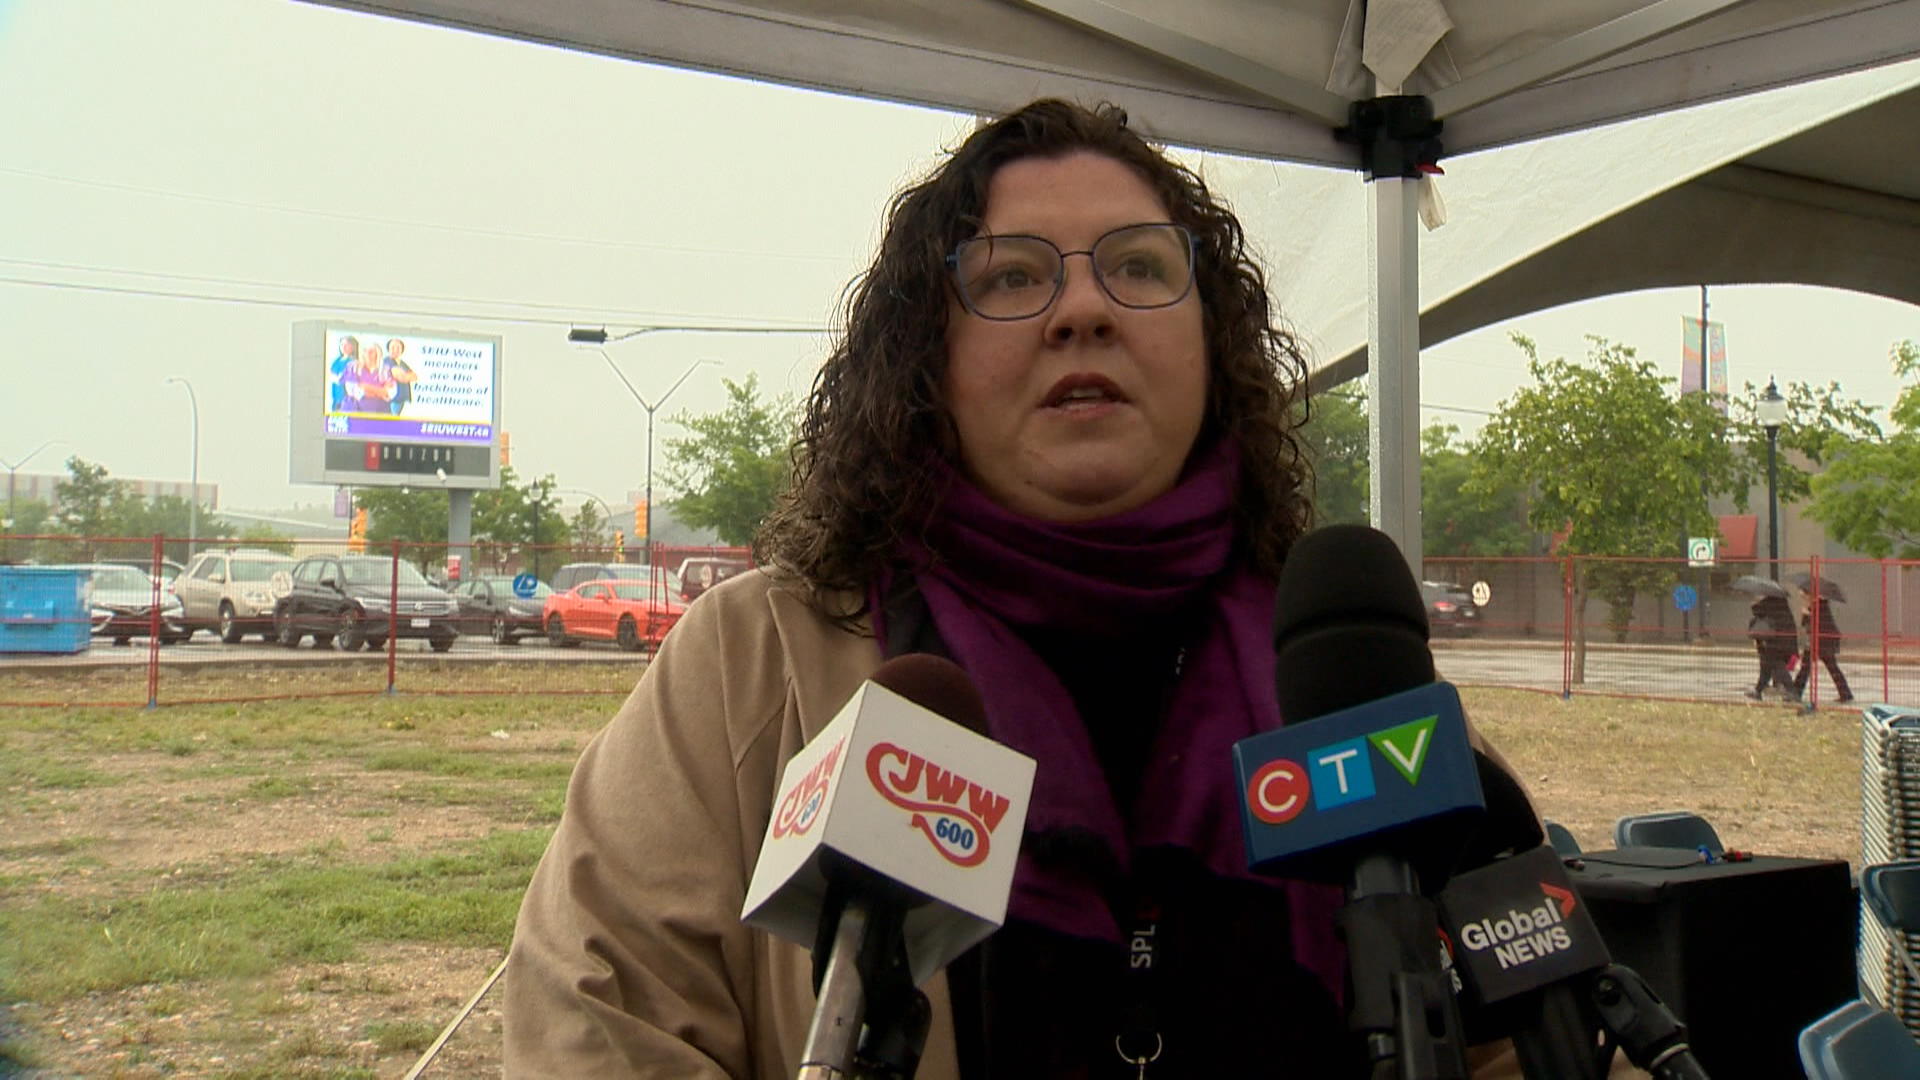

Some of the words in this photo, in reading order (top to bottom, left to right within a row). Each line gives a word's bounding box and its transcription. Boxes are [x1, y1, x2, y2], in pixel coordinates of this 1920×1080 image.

[424, 360, 478, 370] members
[430, 371, 449, 380] are
[453, 373, 472, 382] the
[414, 383, 472, 394] backbone
[476, 385, 488, 395] of
[866, 742, 1010, 836] CJWW
[1258, 728, 1427, 813] CTV
[936, 817, 974, 850] 600
[1461, 897, 1561, 950] Global
[1129, 923, 1156, 968] SPL
[1495, 926, 1571, 969] NEWS
